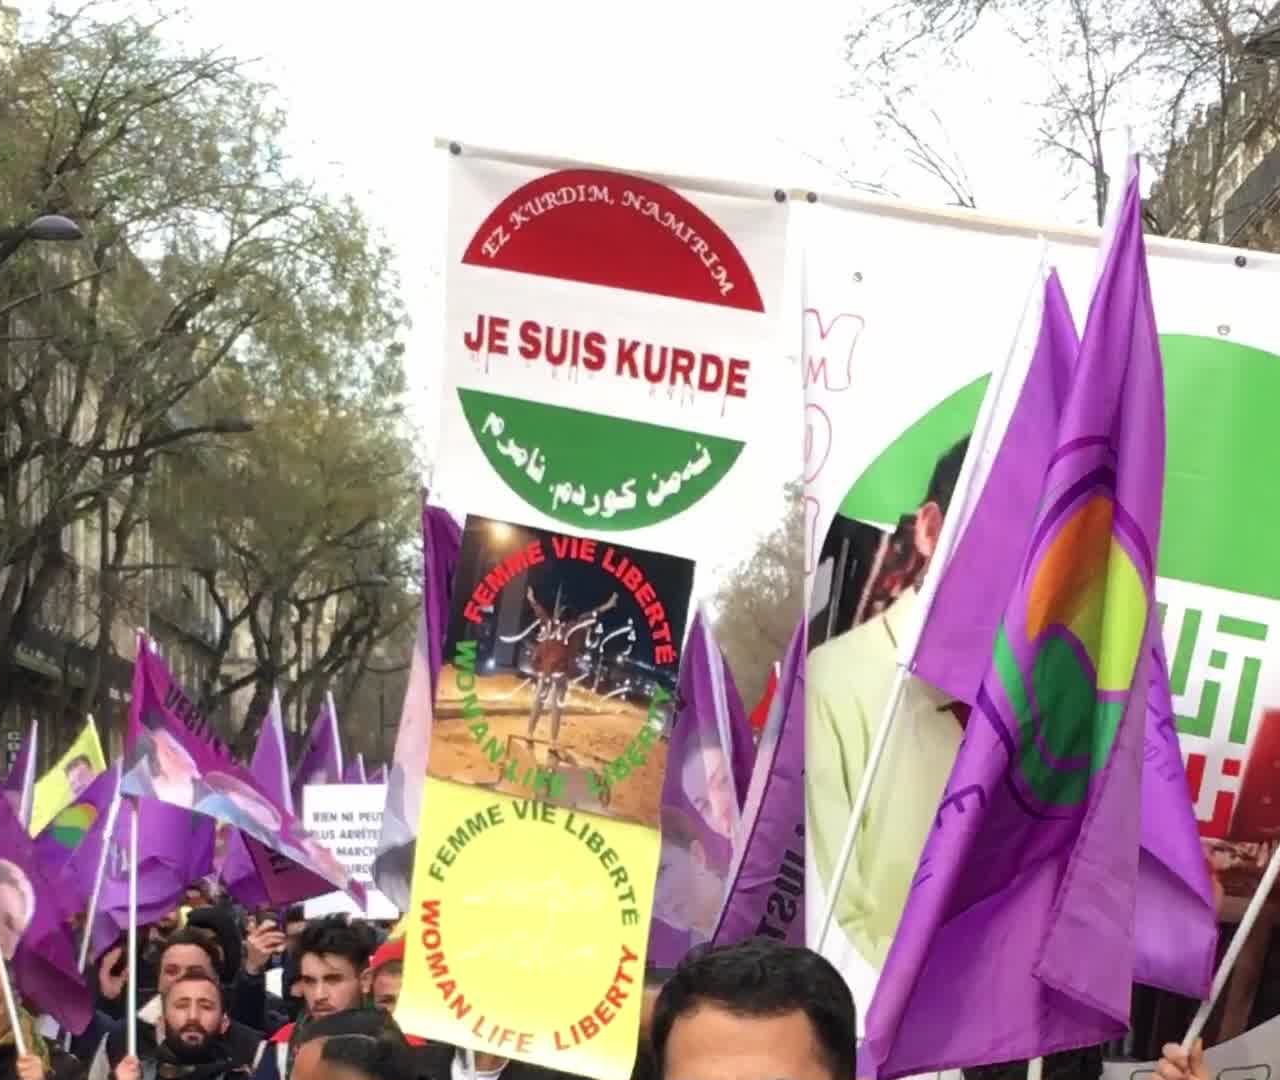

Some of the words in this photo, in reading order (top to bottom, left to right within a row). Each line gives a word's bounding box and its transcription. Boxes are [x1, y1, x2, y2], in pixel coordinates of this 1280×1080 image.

[481, 223, 511, 260] EZ
[622, 188, 735, 297] NAMIRIM
[463, 314, 510, 357] JE
[517, 320, 608, 373] SUIS
[616, 338, 751, 399] KURDE
[463, 539, 545, 624] FEMME
[551, 534, 599, 562] VIE
[454, 640, 505, 763] WOMAN
[428, 804, 505, 883] FEMME
[511, 799, 559, 824] VIE
[420, 899, 472, 1020] WOMAN
[471, 1015, 535, 1054] LIFE
[553, 944, 639, 1052] LIBERTY
